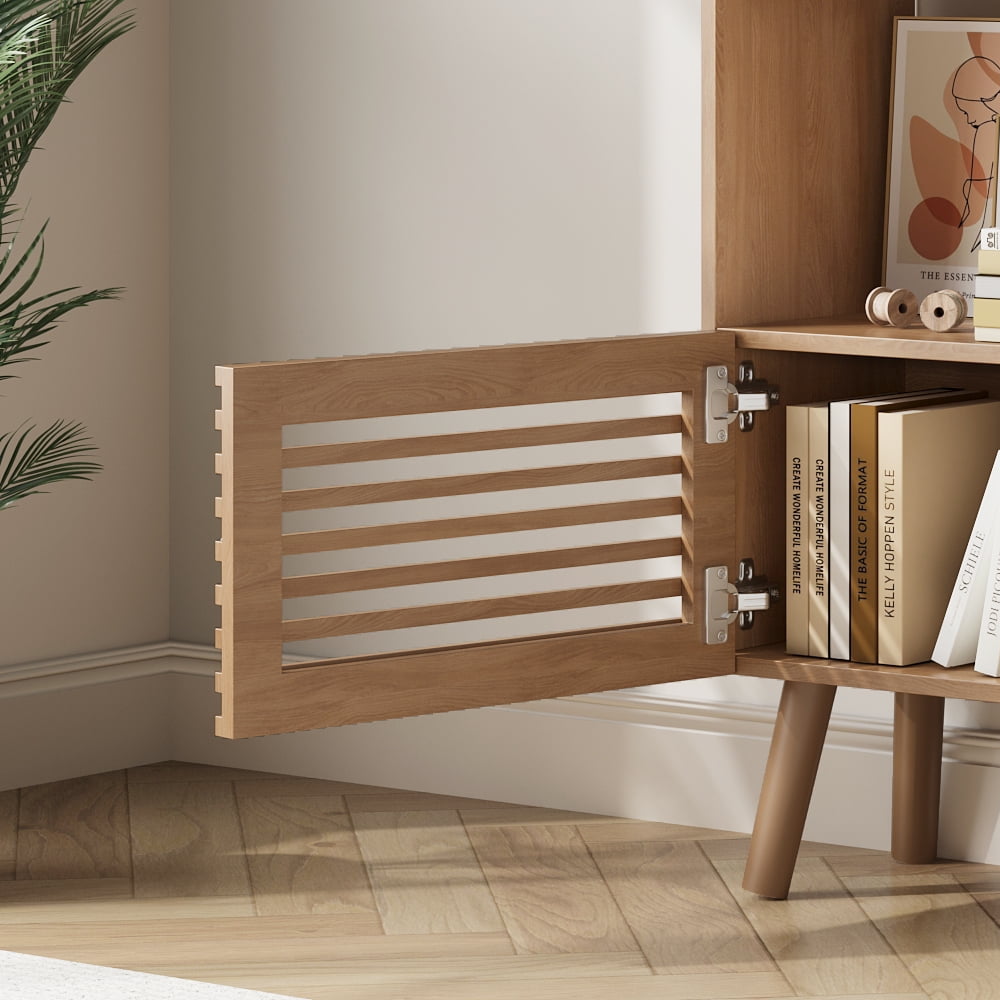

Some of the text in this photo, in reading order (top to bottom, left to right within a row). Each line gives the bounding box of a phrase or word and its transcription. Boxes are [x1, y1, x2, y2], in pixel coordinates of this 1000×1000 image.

[920, 270, 941, 280] THE
[792, 457, 801, 595] CREATE WONDERFUL HOMELIFE
[815, 458, 824, 597] CREATE WONDERFUL HOMELIFE
[858, 458, 867, 602] THE BASIC OF FORMAT
[884, 469, 895, 618] KELLY HOPPEN STYLE
[958, 529, 986, 594] SCHIELE
[986, 607, 1000, 637] JODI
